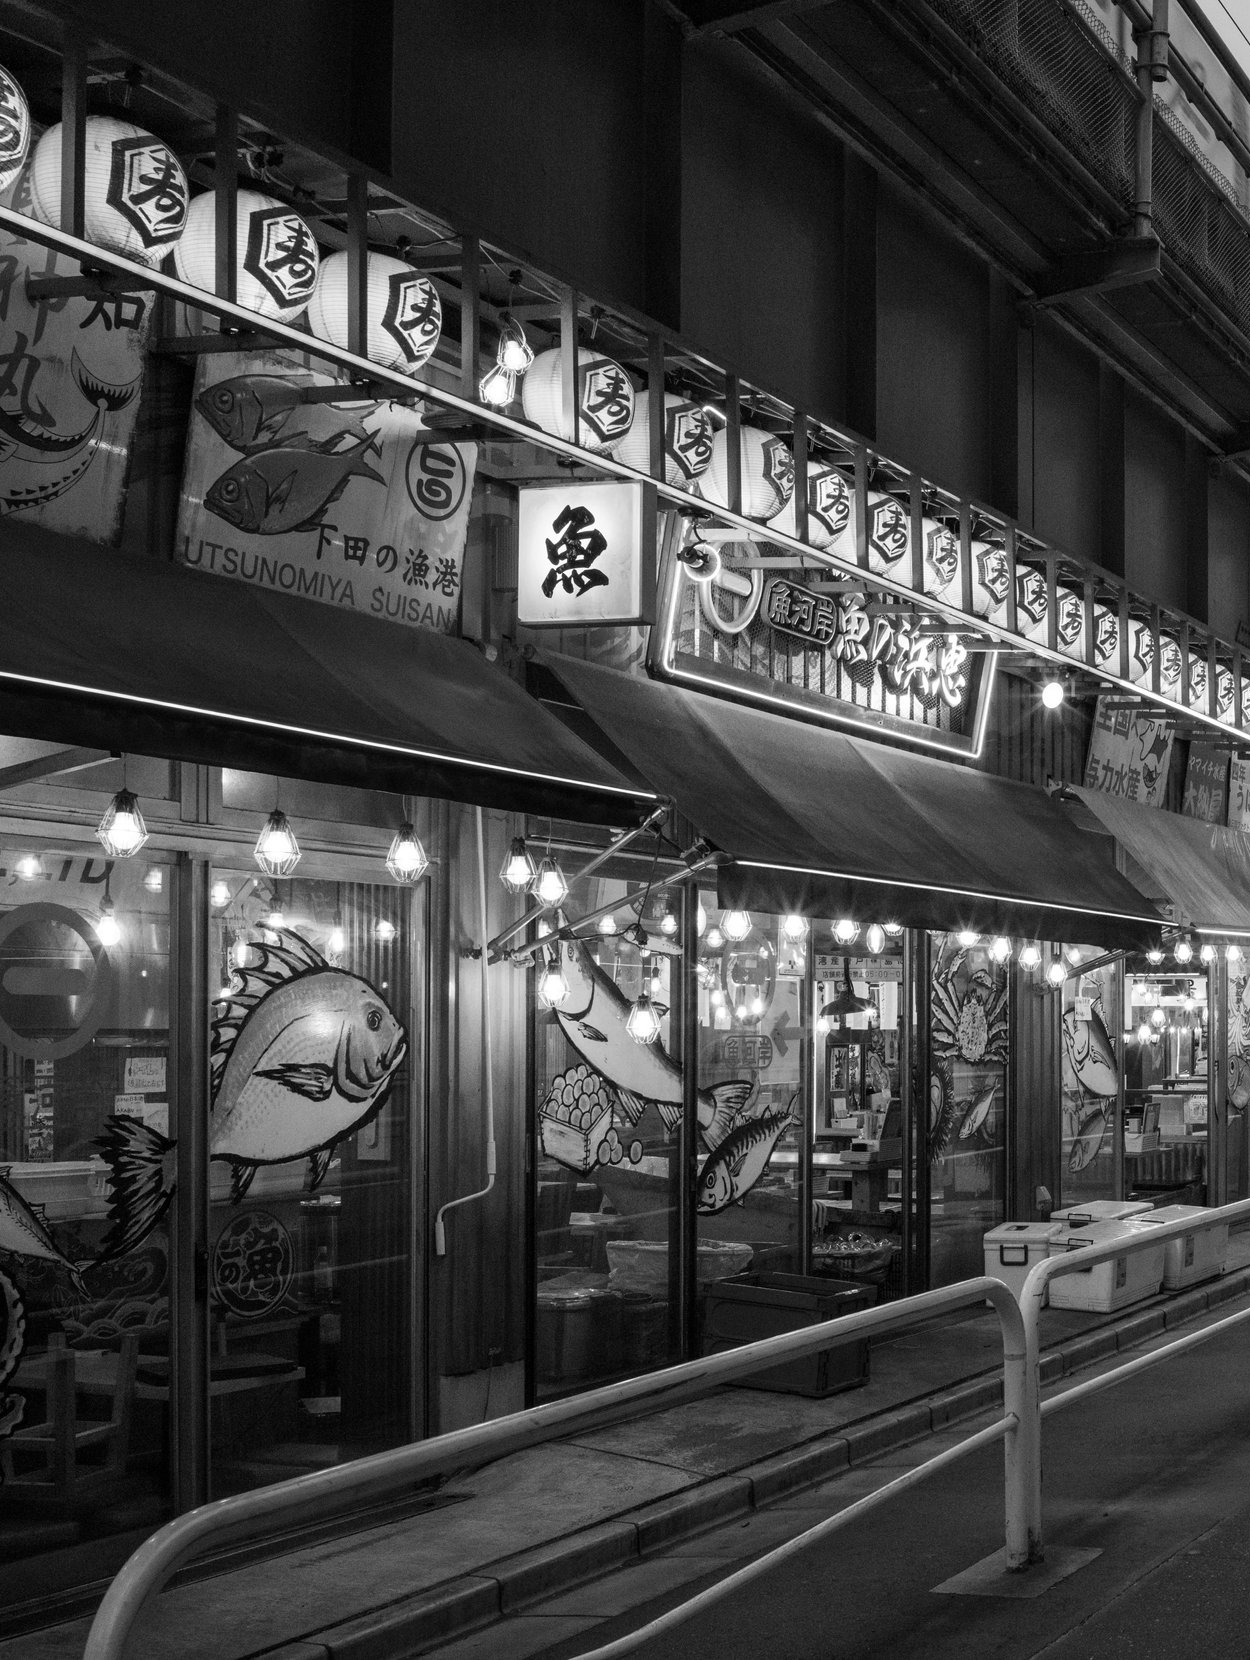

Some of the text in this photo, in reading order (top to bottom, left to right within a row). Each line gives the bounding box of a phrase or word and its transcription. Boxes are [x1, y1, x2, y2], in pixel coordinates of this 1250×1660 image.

[183, 535, 453, 632] UTSUNOMIYA SUISAN
[313, 522, 460, 598] 下田の漁港
[540, 504, 609, 599] 魚
[770, 586, 835, 638] 魚河岸
